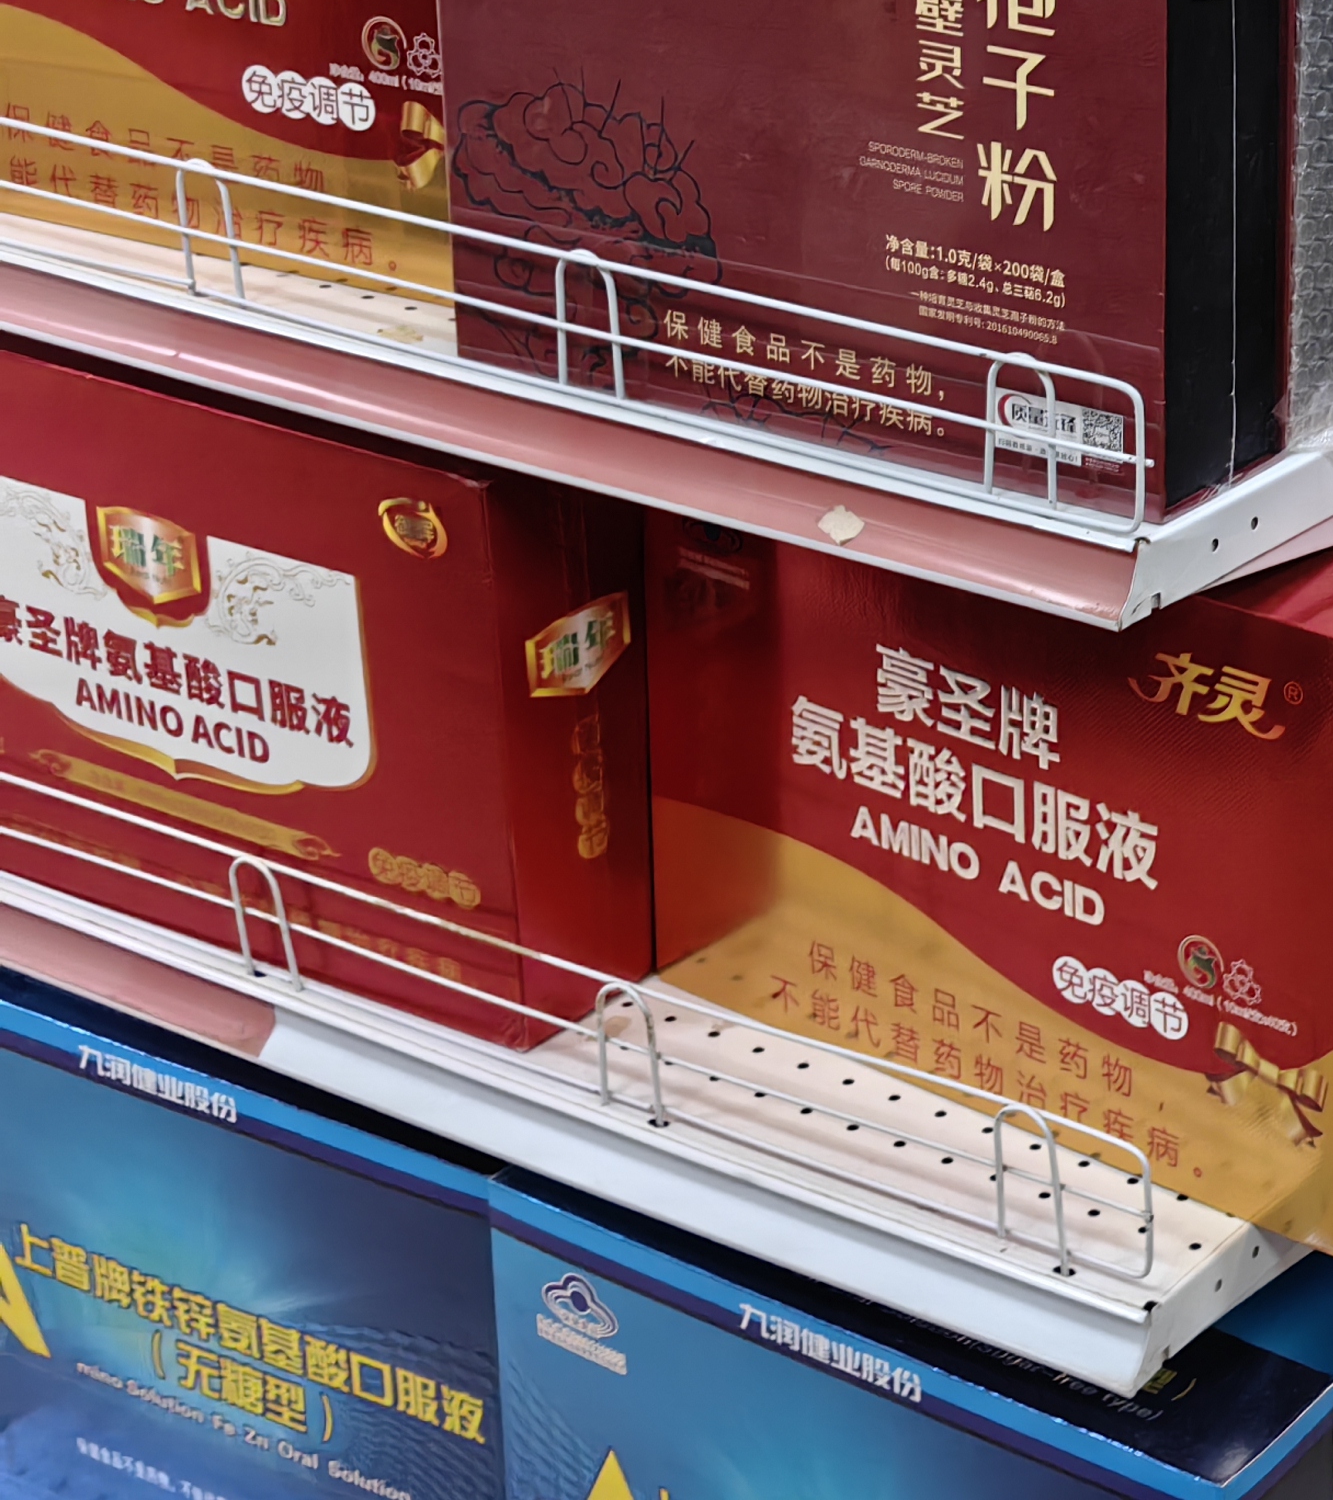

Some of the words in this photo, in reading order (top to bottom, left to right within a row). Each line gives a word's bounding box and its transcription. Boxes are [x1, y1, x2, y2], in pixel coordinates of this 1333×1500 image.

[246, 68, 374, 128] 免疫调节
[74, 678, 185, 740] AMINO
[191, 713, 271, 765] ACID
[875, 643, 1061, 771] 豪圣牌
[790, 695, 1159, 891] 氨基酸口服液
[850, 805, 980, 881] AMINO
[999, 861, 1106, 927] ACID
[1056, 959, 1186, 1036] 免疫调节
[77, 1044, 238, 1124] 九润健业股份
[13, 1221, 487, 1445] 上普牌铁锌氨基酸口服液
[738, 1301, 924, 1404] 九润健业股份
